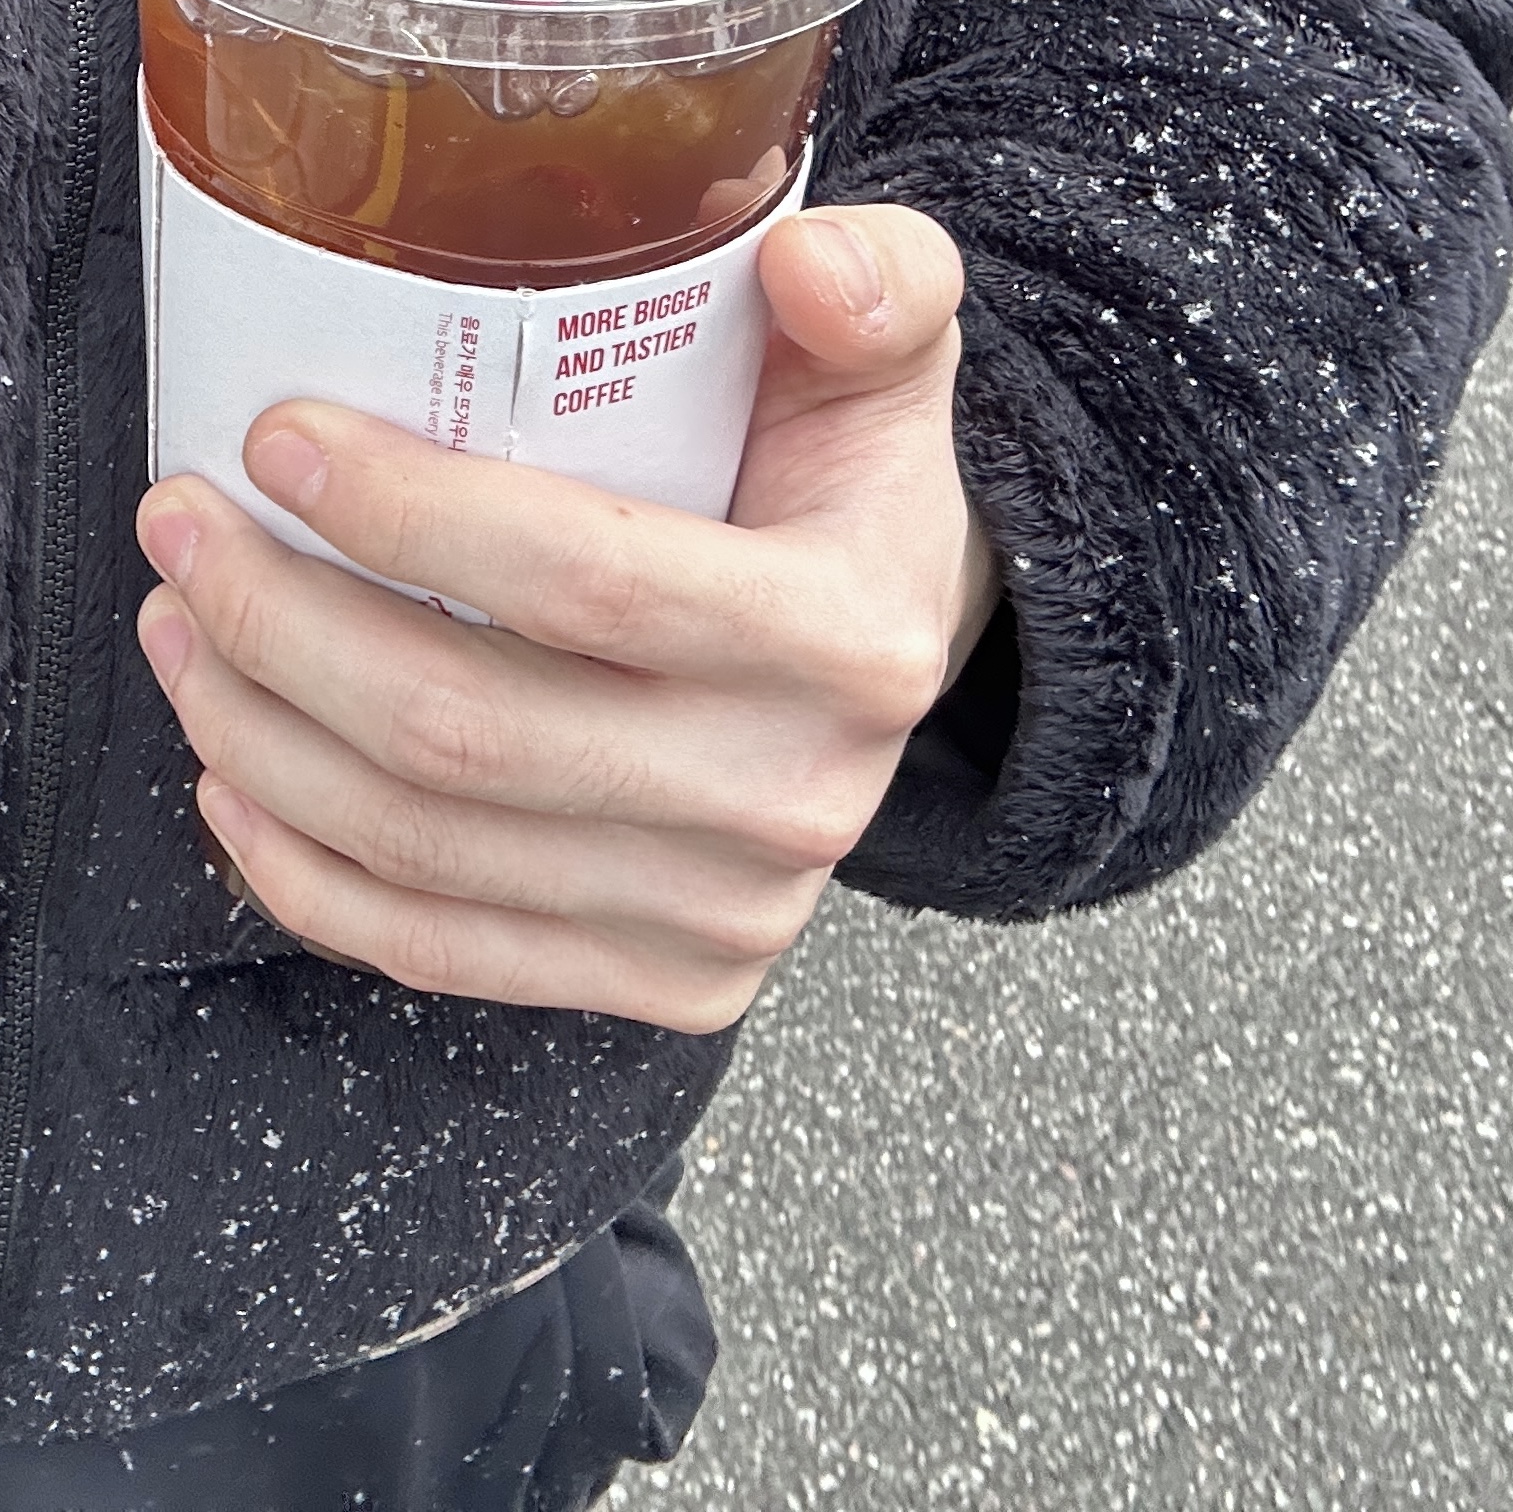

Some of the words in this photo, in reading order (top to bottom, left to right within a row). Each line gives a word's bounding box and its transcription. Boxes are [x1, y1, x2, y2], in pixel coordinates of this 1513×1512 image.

[437, 313, 453, 337] This
[557, 304, 628, 342] MORE
[633, 281, 711, 326] BIGGER
[457, 316, 480, 360] 음료가
[555, 347, 604, 380] AND
[611, 321, 697, 368] TASTIER
[429, 339, 450, 395] beverage
[454, 364, 475, 393] 매우
[430, 397, 444, 407] is
[553, 375, 636, 416] COFFEE
[425, 410, 439, 436] very
[447, 396, 471, 452] 뜨거우니
